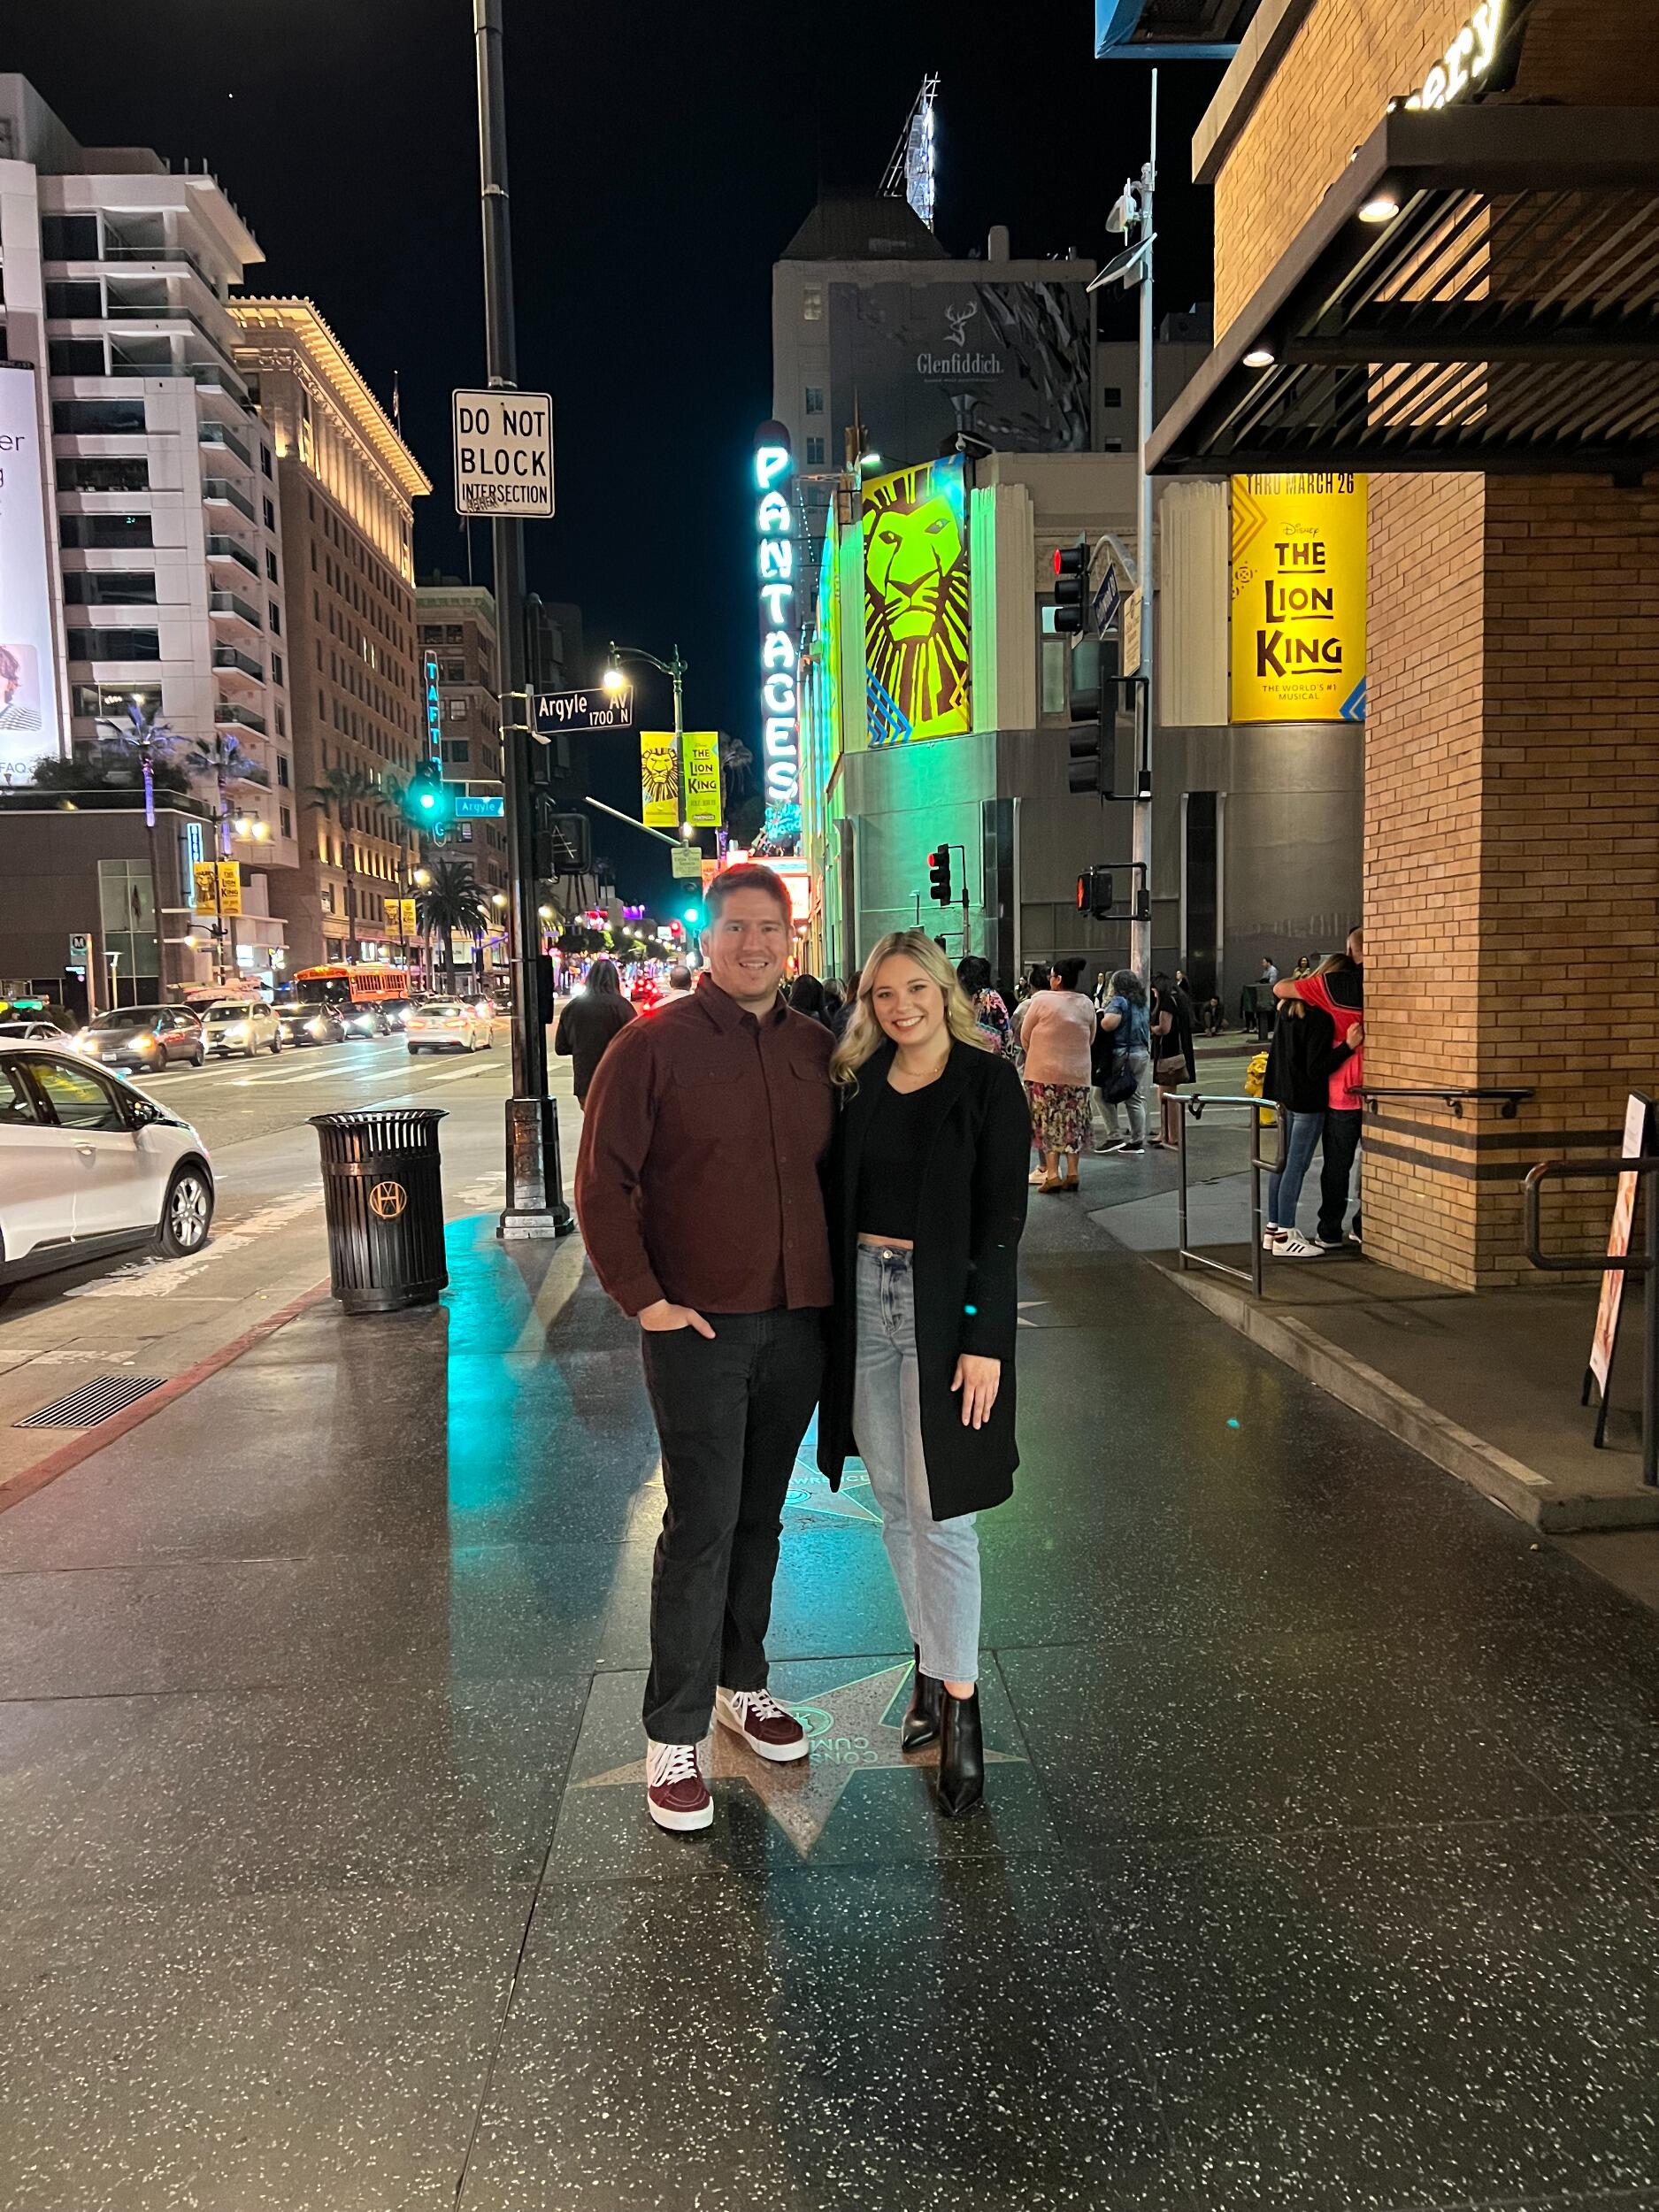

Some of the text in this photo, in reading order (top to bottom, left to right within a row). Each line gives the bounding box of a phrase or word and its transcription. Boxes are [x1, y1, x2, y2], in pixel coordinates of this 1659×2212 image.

[459, 408, 546, 437] DO NOT
[461, 448, 547, 476] BLOCK
[462, 483, 548, 503] INTERSECTION
[1247, 473, 1354, 495] THRU MARCH 26
[1274, 541, 1325, 566] THE
[1264, 580, 1334, 624] LION
[756, 447, 799, 799] PANTAGES
[1256, 629, 1343, 679] KING
[426, 662, 440, 744] TAFT
[539, 692, 627, 722] Argyle AV
[589, 708, 628, 726] 1700 N
[687, 779, 717, 794] KING
[462, 802, 495, 813] Argyle
